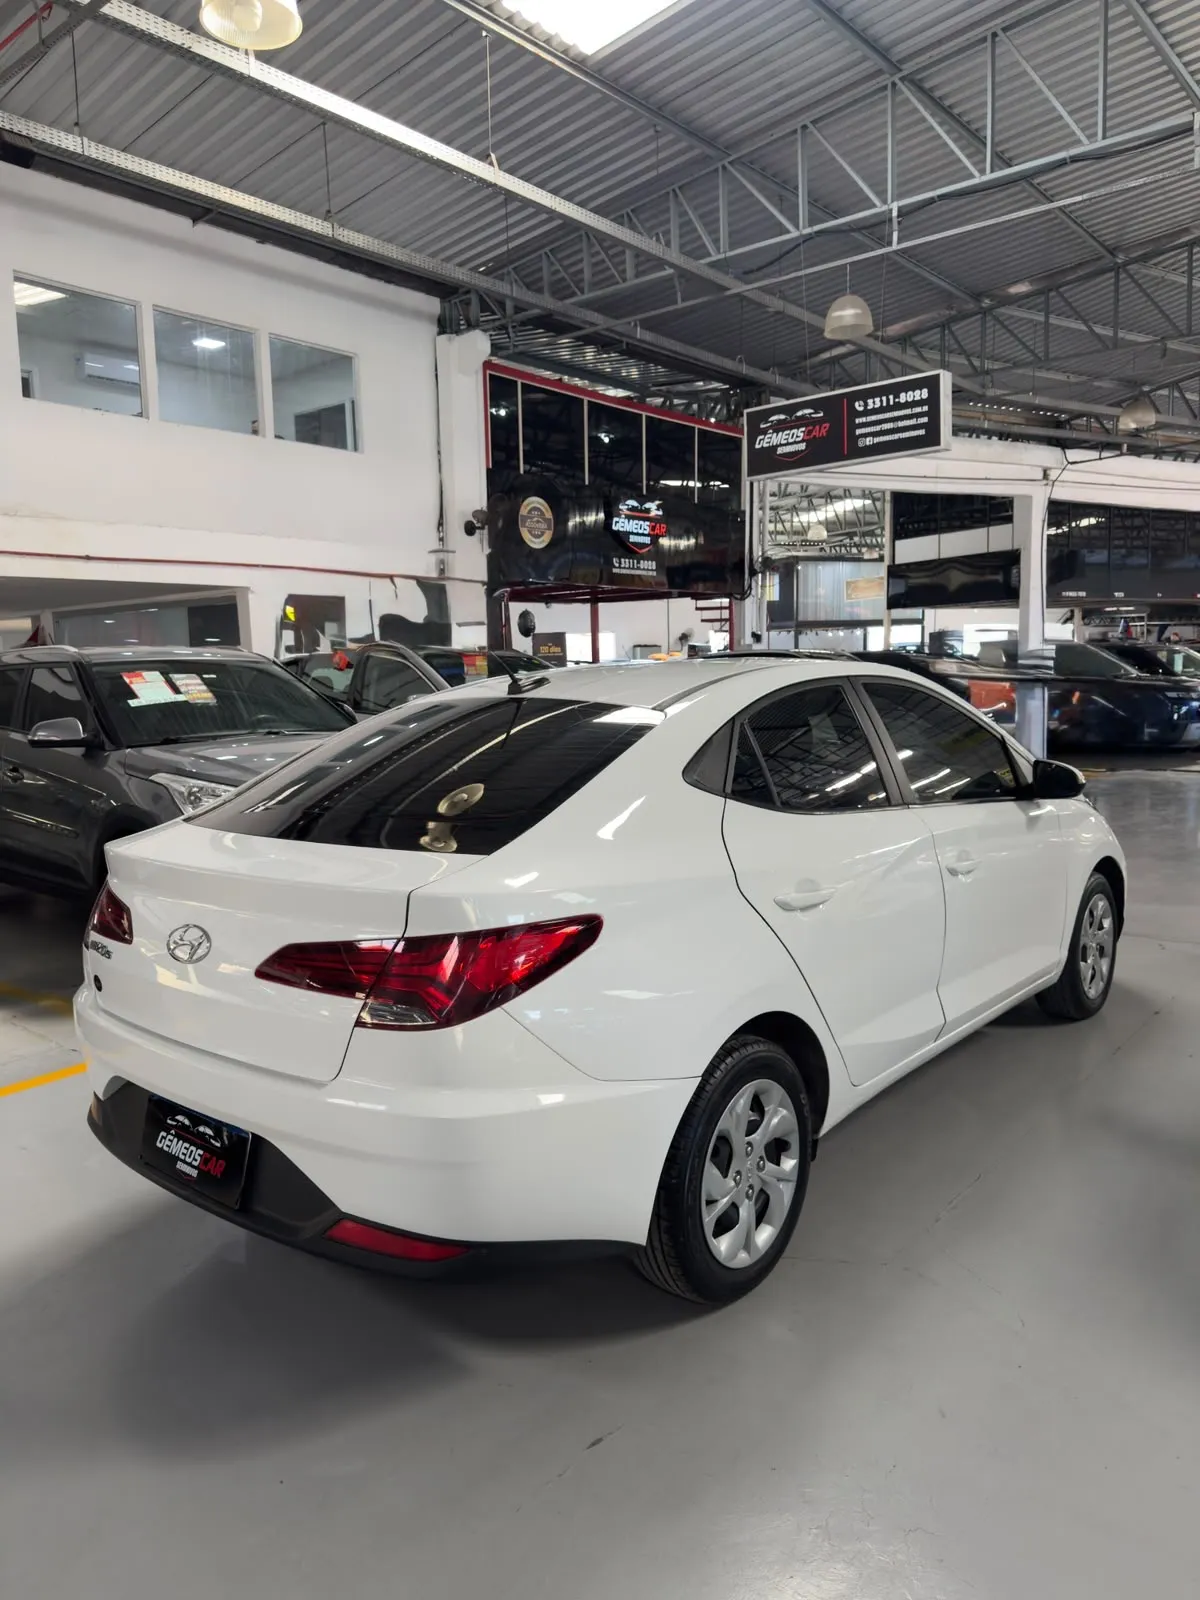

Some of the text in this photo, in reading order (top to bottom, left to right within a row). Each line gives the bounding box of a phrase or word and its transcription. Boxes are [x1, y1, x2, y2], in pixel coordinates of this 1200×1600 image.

[867, 388, 928, 409] 3311-8028
[755, 422, 831, 449] GÊMEOSCAR
[156, 1129, 225, 1178] GÊMEOSCAR
